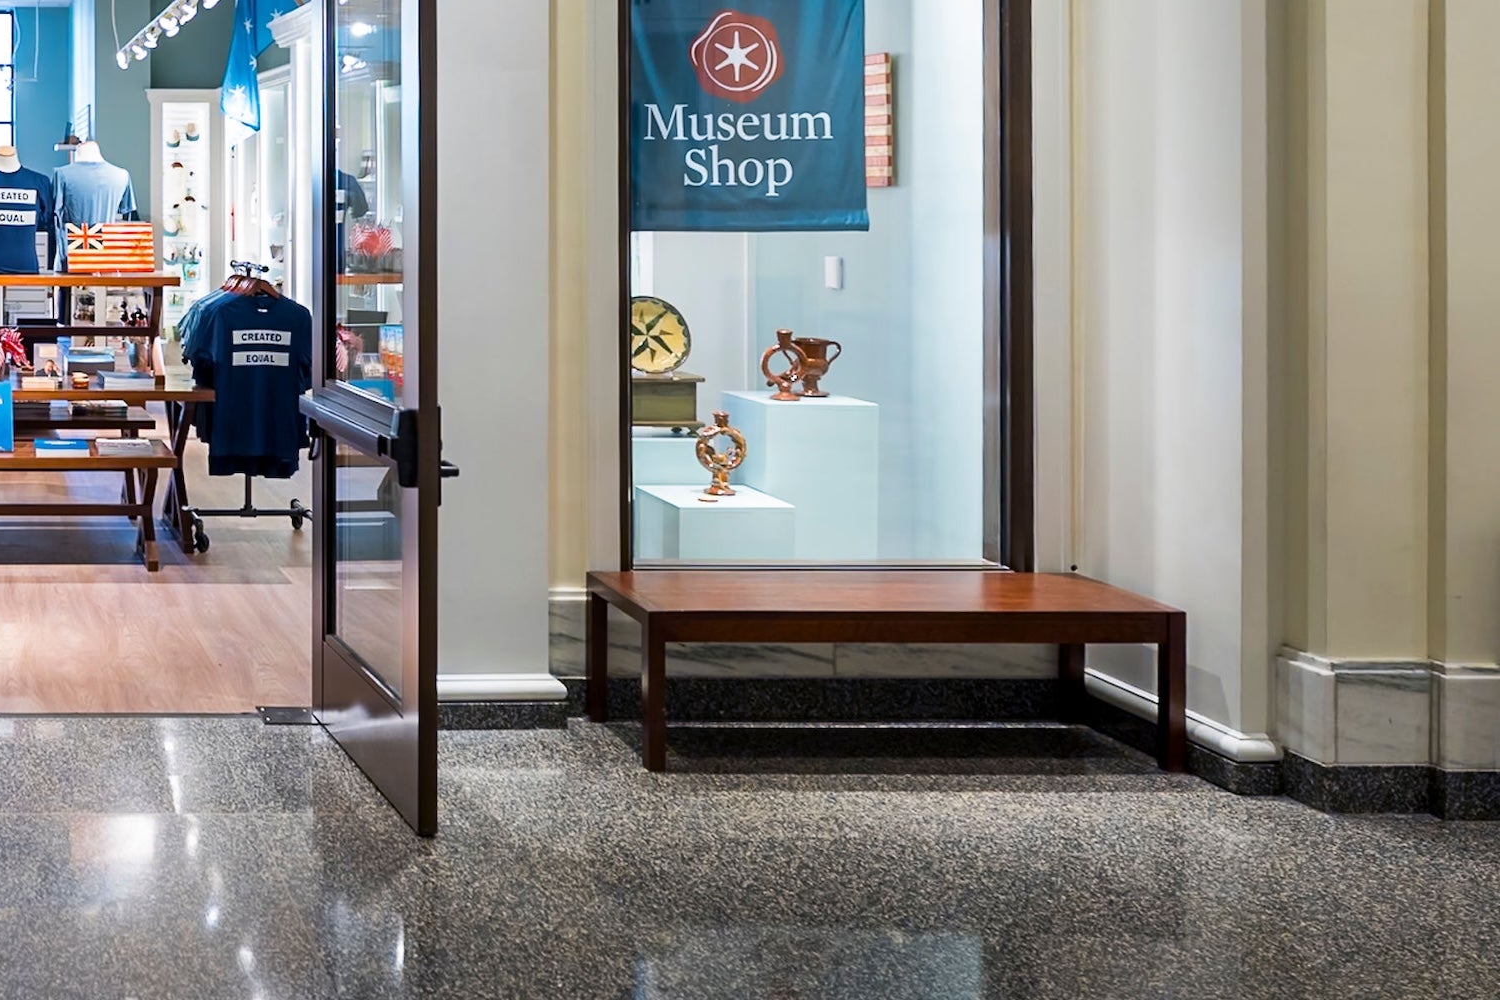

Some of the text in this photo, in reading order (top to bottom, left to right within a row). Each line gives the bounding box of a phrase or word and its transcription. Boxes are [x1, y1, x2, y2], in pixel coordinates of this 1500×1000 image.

[643, 103, 833, 141] Museum
[683, 144, 793, 197] Shop
[241, 333, 282, 342] CREATED
[246, 354, 276, 363] EQUAL
